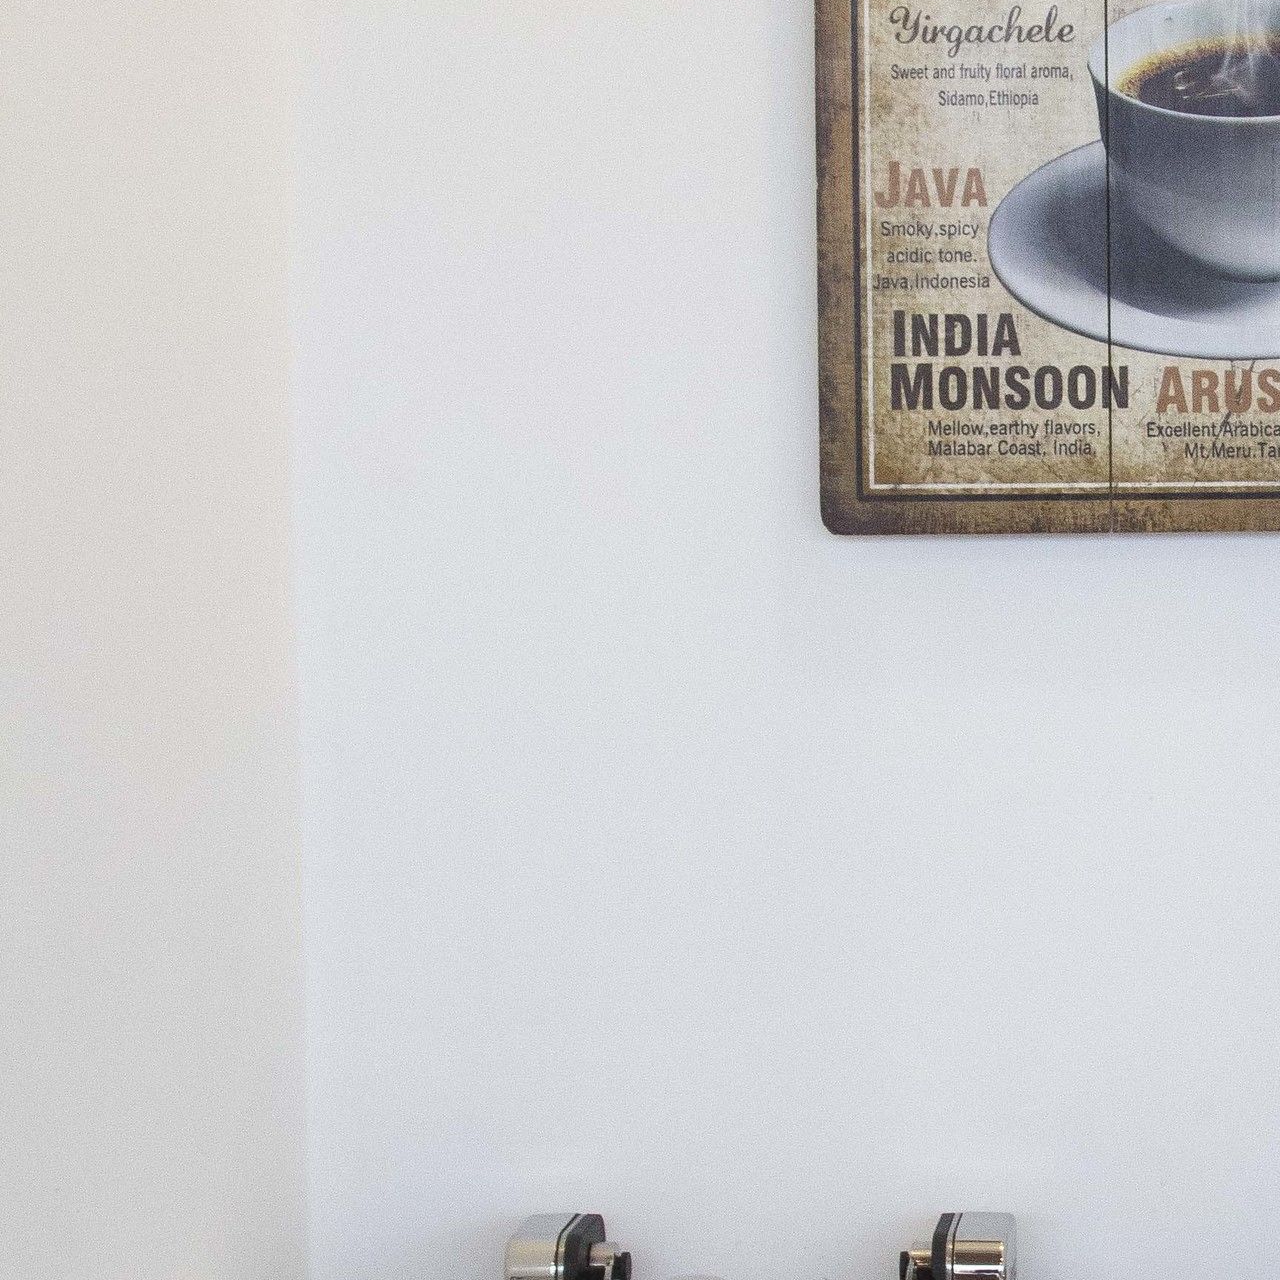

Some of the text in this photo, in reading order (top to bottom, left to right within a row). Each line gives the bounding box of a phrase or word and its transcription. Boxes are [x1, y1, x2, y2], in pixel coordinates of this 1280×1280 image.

[890, 62, 1074, 83] Sweet and fruity floral aroma,
[873, 160, 989, 209] JAVA
[886, 248, 932, 264] acidic
[892, 309, 1022, 357] INDIA
[890, 362, 1129, 411] MONSOON
[1146, 420, 1218, 438] Excellent
[927, 440, 993, 457] Malabar
